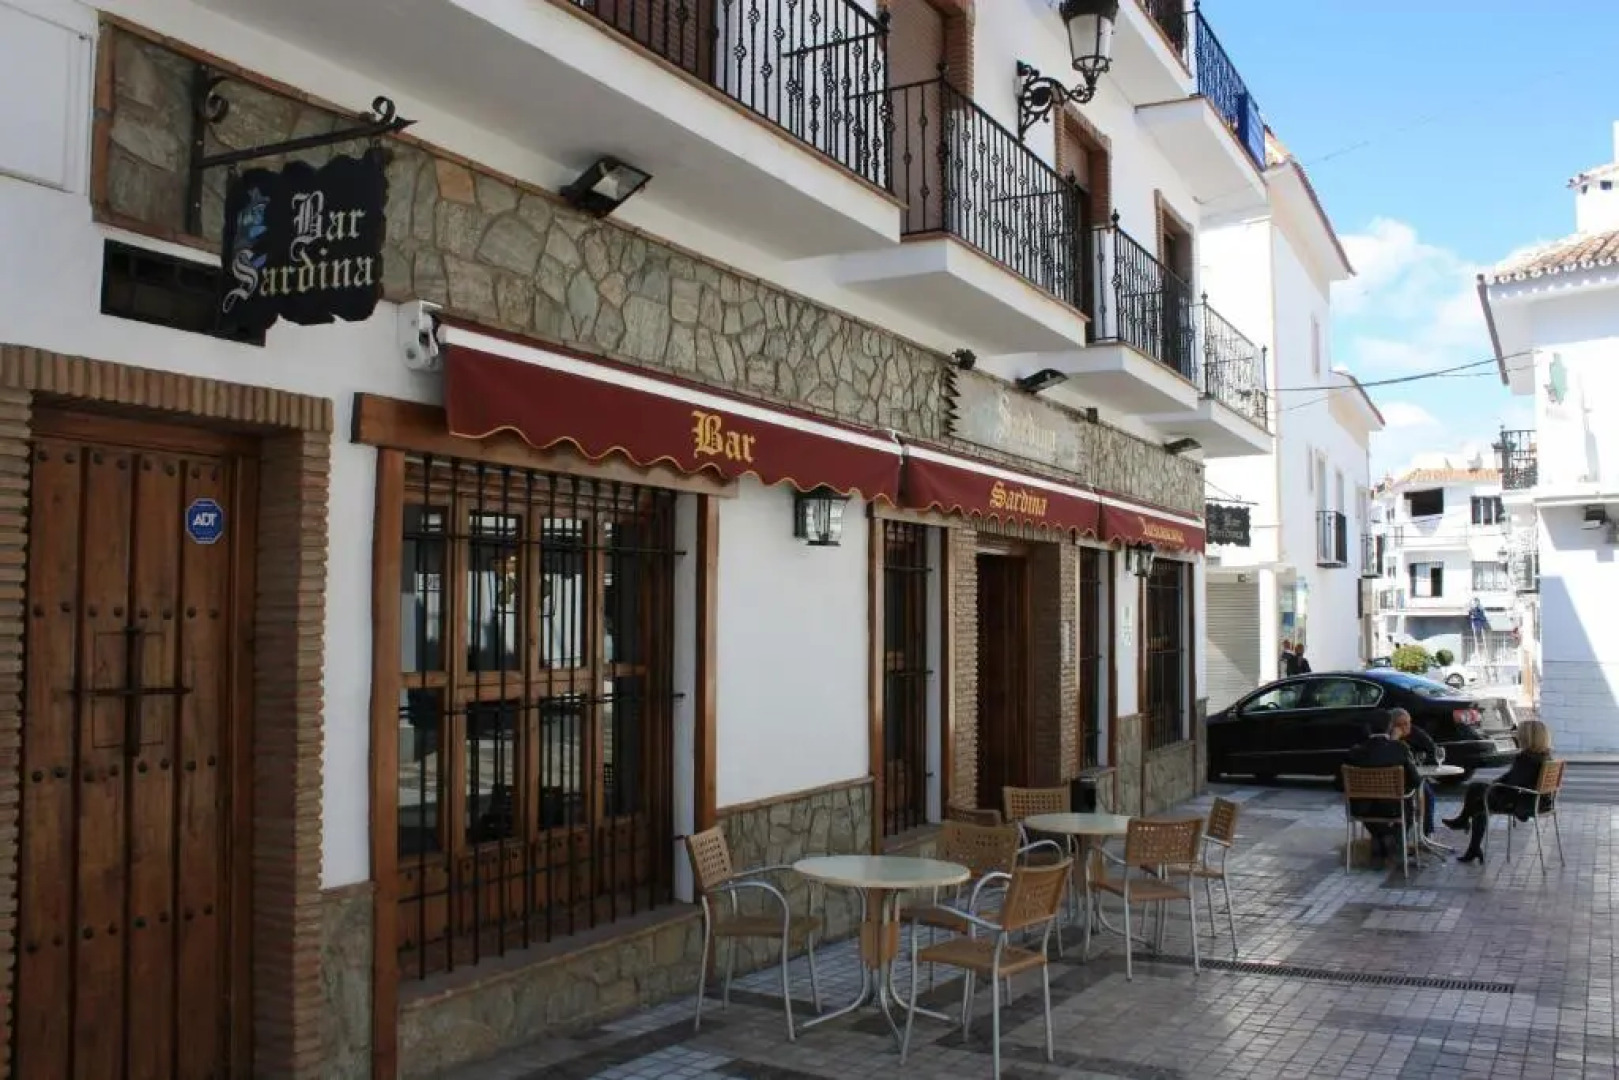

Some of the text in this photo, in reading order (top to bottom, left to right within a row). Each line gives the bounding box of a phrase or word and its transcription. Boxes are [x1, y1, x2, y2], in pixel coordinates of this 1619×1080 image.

[291, 190, 366, 261] Bar
[222, 248, 374, 314] Sardina
[691, 410, 757, 463] Bar
[193, 512, 218, 527] ADT
[990, 480, 1048, 517] Sardina
